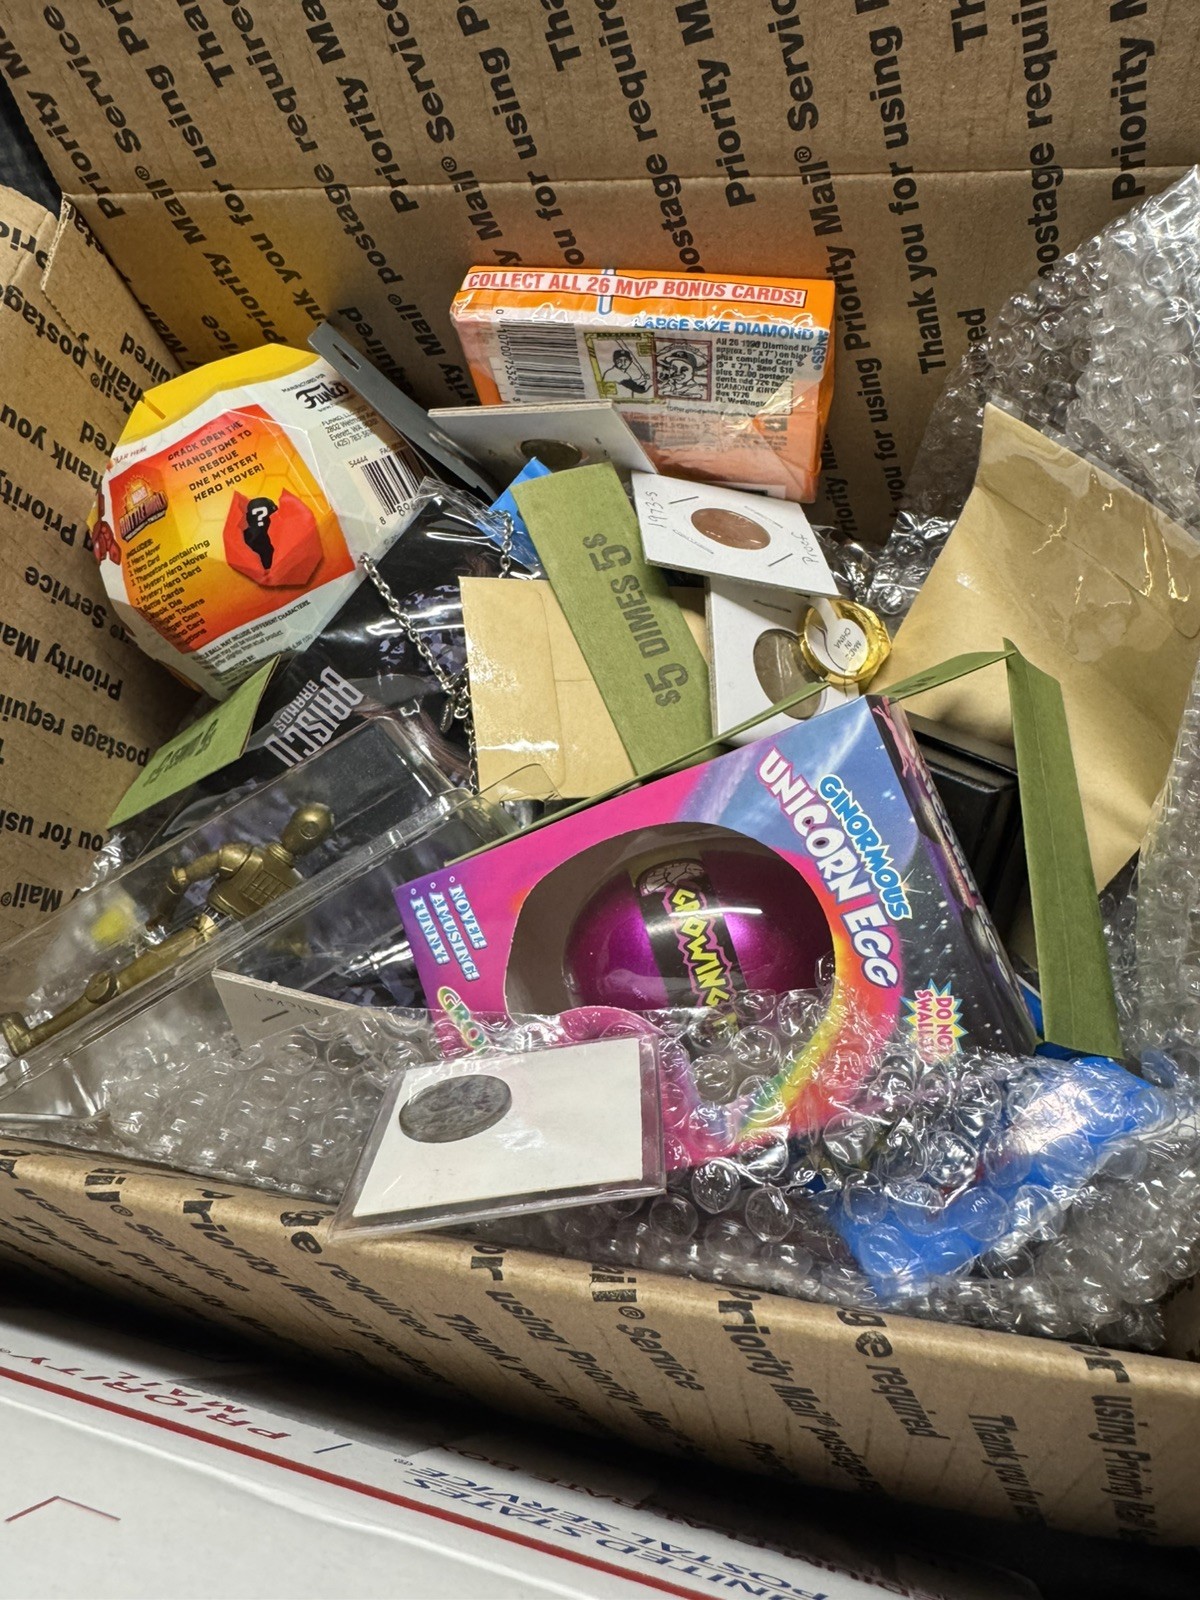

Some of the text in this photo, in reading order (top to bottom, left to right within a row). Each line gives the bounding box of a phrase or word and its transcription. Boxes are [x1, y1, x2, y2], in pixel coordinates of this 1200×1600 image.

[43, 5, 142, 154] Service
[335, 76, 420, 213] Priority
[696, 59, 757, 208] Priority
[1112, 38, 1156, 201] Priority
[27, 90, 126, 219] Priority
[146, 64, 303, 284] you for using
[479, 48, 586, 266] ou for using
[313, 163, 401, 286] postage
[645, 153, 705, 273] ostage
[869, 26, 947, 375] Thank you for using
[203, 251, 288, 345] Priority
[468, 273, 804, 305] COLLECT ALL 26 MVP BONUS CARDS!
[825, 245, 872, 352] Priority
[633, 316, 816, 341] LARGE SIZE DIAMOND
[762, 341, 799, 352] Diamond
[854, 357, 891, 424] using
[0, 403, 47, 451] you
[167, 420, 244, 462] CRACK OPEN THE
[238, 429, 253, 442] TO
[873, 429, 898, 462] for
[188, 452, 260, 492] ONE MYSTERY
[199, 450, 240, 475] RESCUE
[193, 483, 224, 503] HERO
[168, 539, 211, 565] containing
[181, 566, 203, 581] Card
[183, 551, 209, 569] Mover
[25, 565, 108, 629] Service
[161, 586, 186, 602] Cards
[175, 598, 206, 617] Tokens
[610, 574, 670, 659] DIMES
[44, 642, 124, 702] Priority
[643, 663, 689, 708] $5
[272, 679, 320, 733] BRANDS
[71, 722, 150, 768] postage
[38, 822, 73, 850] for
[78, 831, 104, 852] ou
[816, 773, 913, 920] GINORMOUS
[757, 746, 901, 990] UNICORN EGG
[935, 996, 954, 1020] DO
[14, 1187, 119, 1246] using
[183, 1187, 291, 1280] Priority
[124, 1221, 250, 1292] Service
[314, 1260, 453, 1342] required
[485, 1289, 570, 1346] using
[432, 1313, 522, 1364] Thank
[615, 1322, 706, 1392] Service
[715, 1286, 795, 1383] Priority
[118, 1370, 248, 1414] MAIL
[865, 1363, 951, 1441] required
[1088, 1394, 1149, 1447] using
[968, 1413, 1030, 1459] Thank
[404, 1478, 583, 1538] STATES
[631, 1531, 829, 1600] POSTAL
